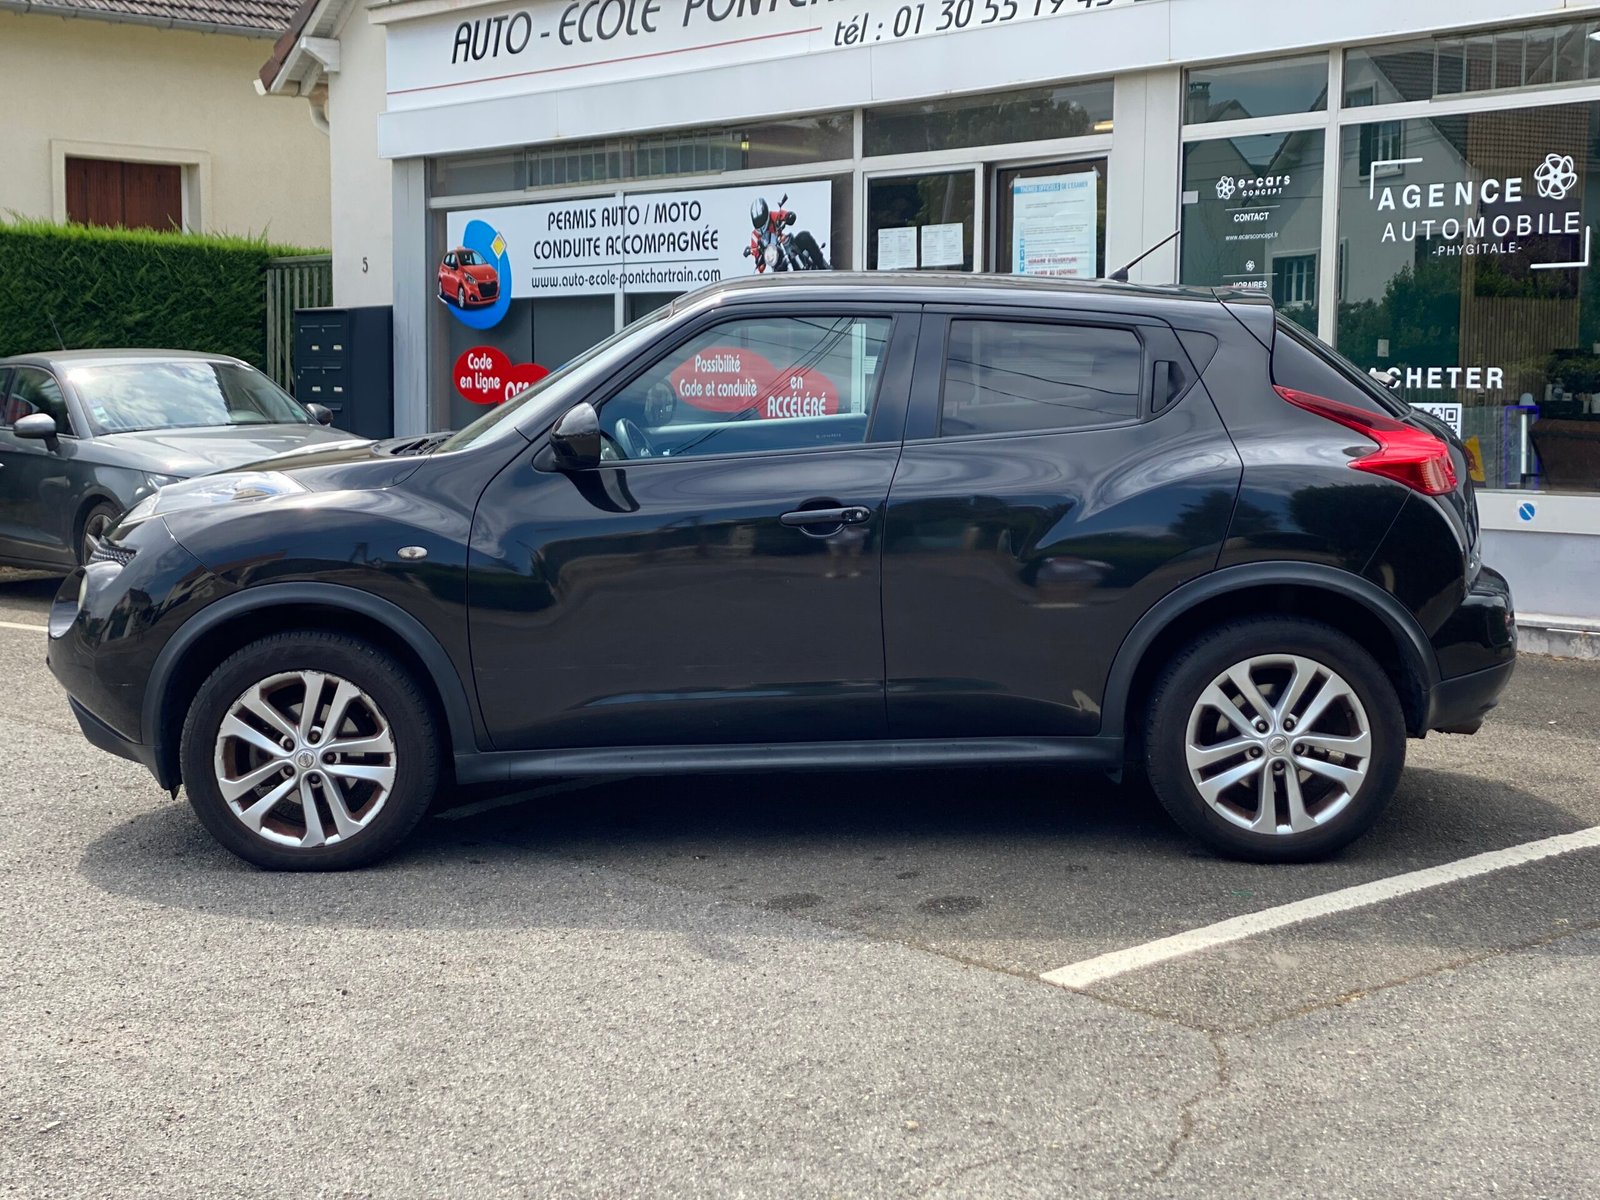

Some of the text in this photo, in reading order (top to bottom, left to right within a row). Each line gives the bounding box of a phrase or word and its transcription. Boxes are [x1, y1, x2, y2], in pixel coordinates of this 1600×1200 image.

[834, 13, 868, 47] tél
[893, 5, 924, 37] 01
[935, 0, 974, 31] 30
[981, 0, 1018, 24] 55
[451, 11, 532, 64] AUTO
[1238, 175, 1291, 188] e-cars
[1242, 187, 1283, 197] CONCEPT
[1377, 177, 1522, 211] AGENCE
[548, 208, 597, 231] PERMIS
[601, 205, 640, 228] AUTO
[654, 200, 702, 224] MOTO
[1233, 212, 1270, 222] CONTACT
[1381, 211, 1580, 243] AUTOMOBILE
[533, 224, 719, 260] CONDUITE ACCOMPAGNÉE
[362, 256, 369, 274] 5
[531, 266, 721, 289] www.auto-ecole-pontchartrain.com
[467, 352, 493, 370] Code
[695, 354, 741, 373] Possibilité
[459, 376, 473, 389] en
[475, 372, 501, 394] Ligne
[679, 378, 703, 397] Code
[705, 380, 715, 397] et
[790, 376, 804, 389] en
[1368, 367, 1504, 389] CHETER
